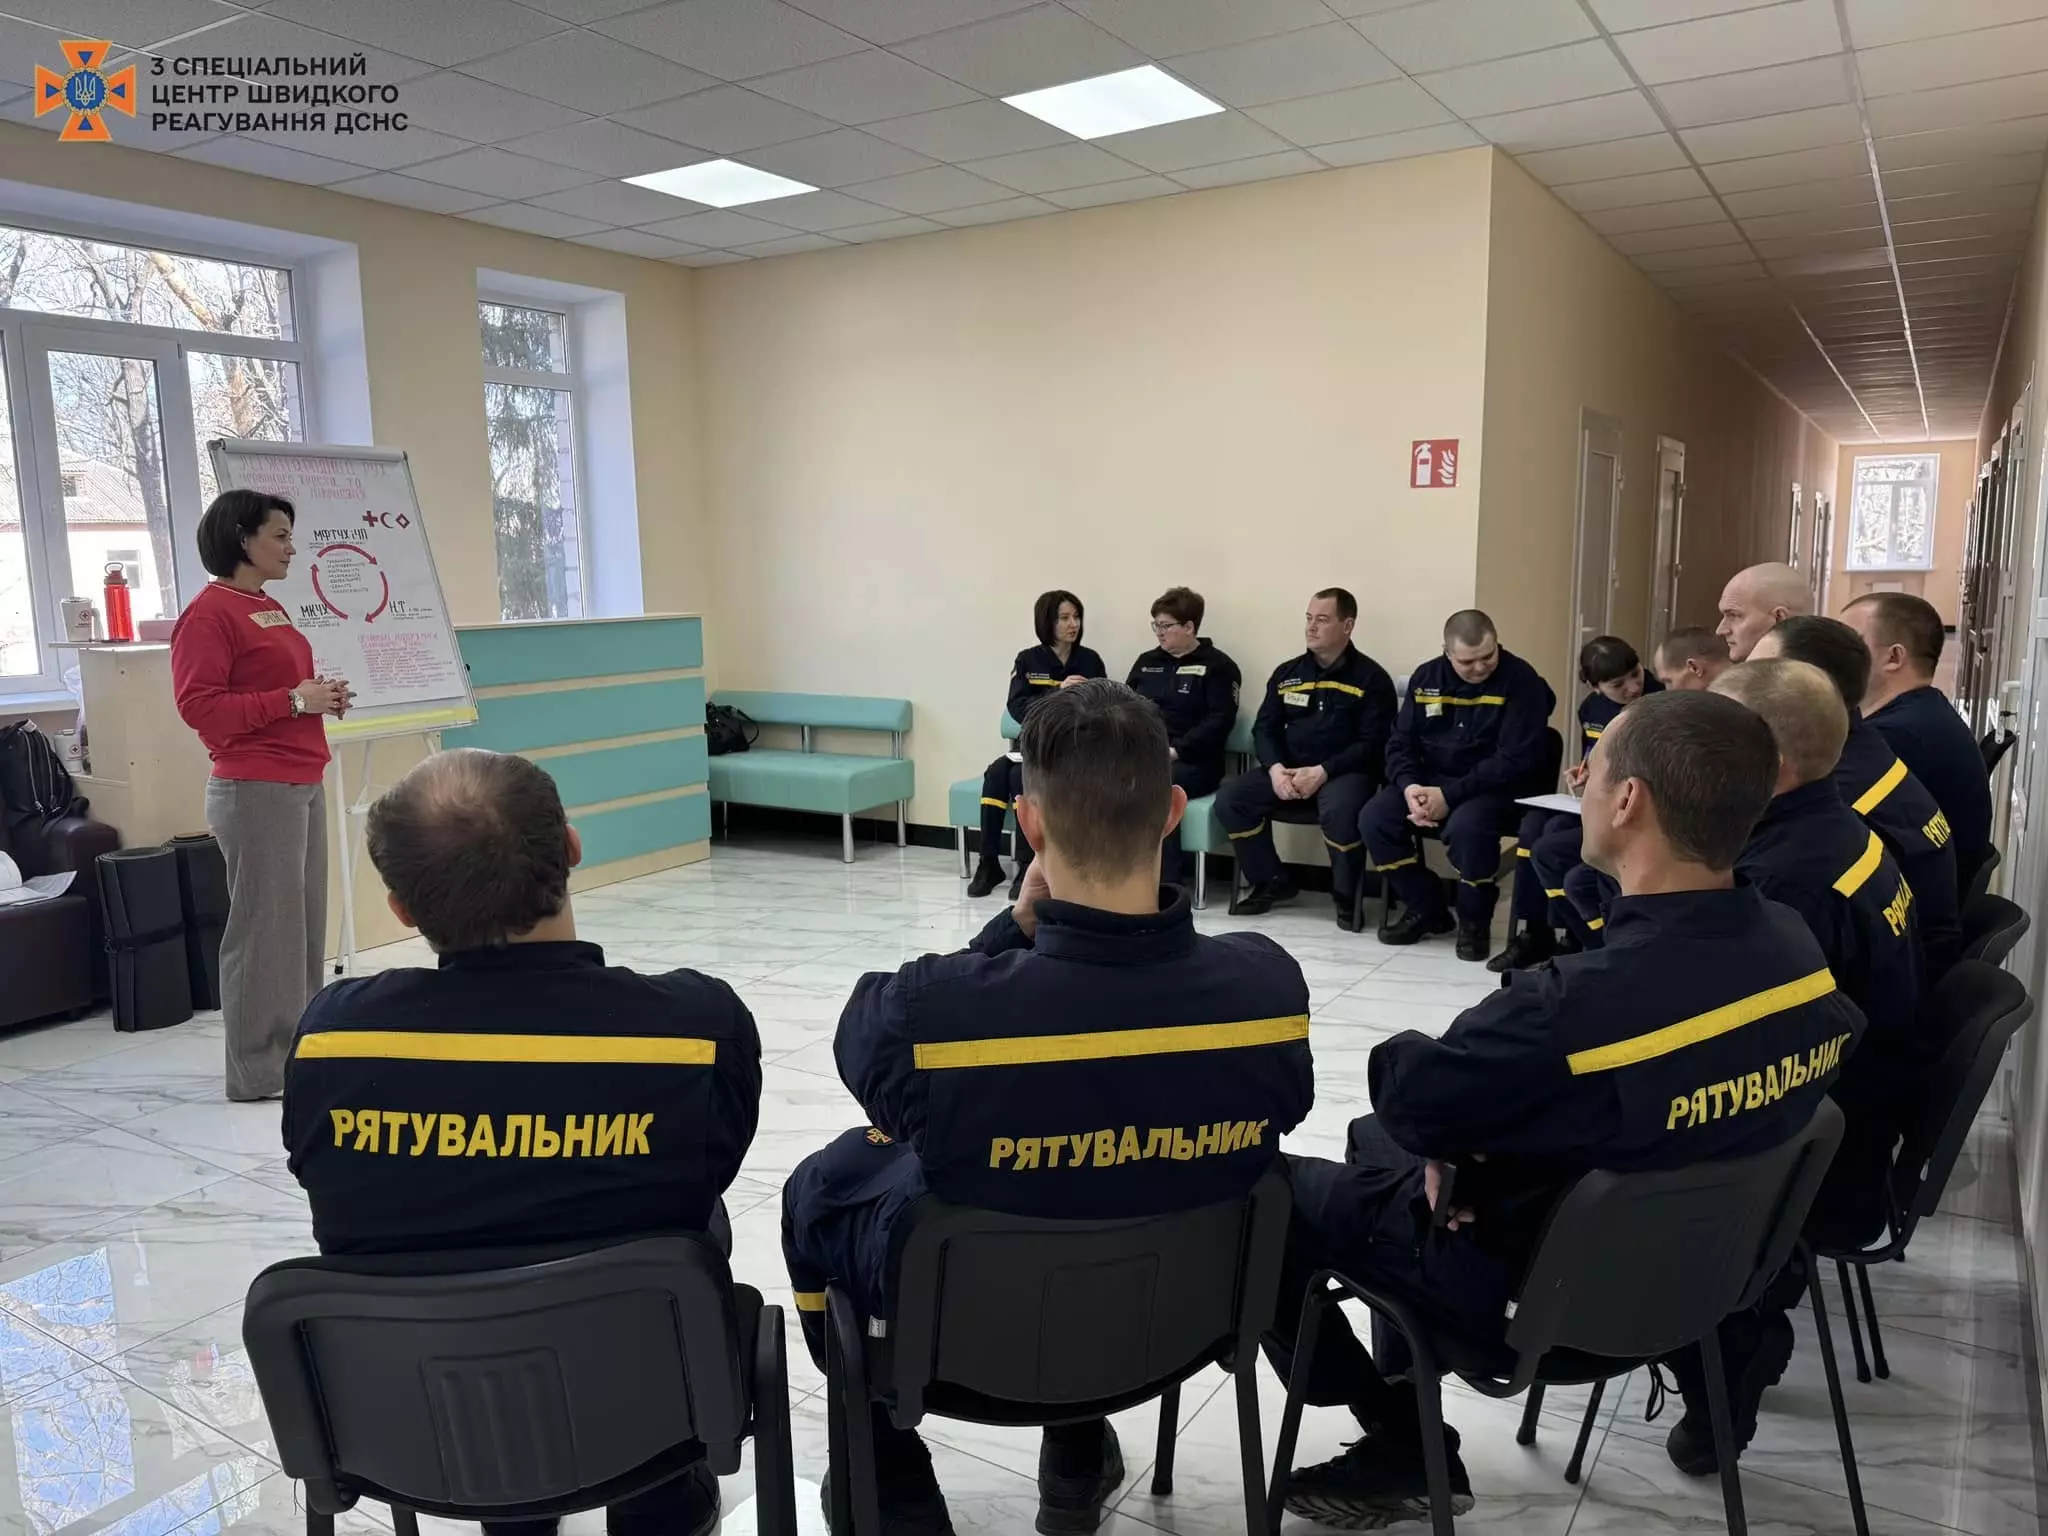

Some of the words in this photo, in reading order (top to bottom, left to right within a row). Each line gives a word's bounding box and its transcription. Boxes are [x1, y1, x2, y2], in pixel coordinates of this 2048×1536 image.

[1666, 1032, 1851, 1130] РЯТУВАЛЬНИК
[329, 1109, 654, 1158] РЯТУВАЛЬНИК
[989, 1118, 1269, 1171] РЯТУВАЛЬНИК
